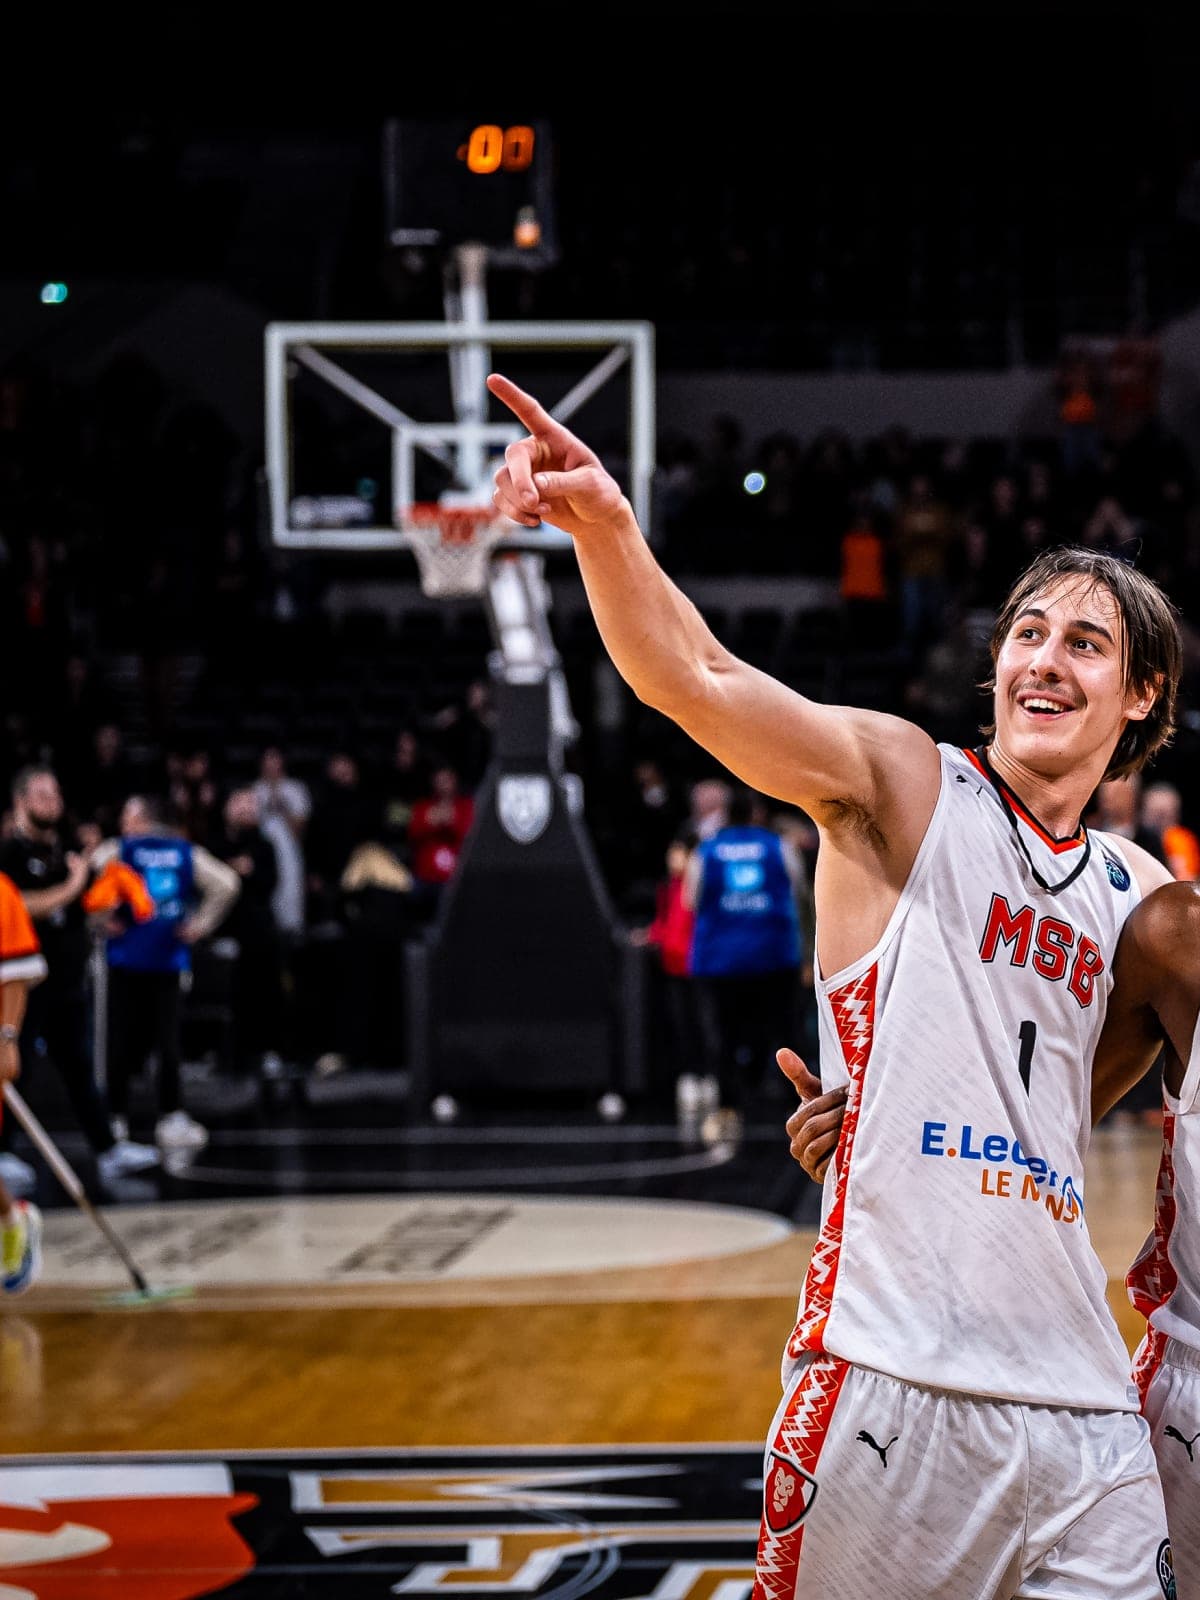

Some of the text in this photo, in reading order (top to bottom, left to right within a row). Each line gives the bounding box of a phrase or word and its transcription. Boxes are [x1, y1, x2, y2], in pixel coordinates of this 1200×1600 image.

[979, 892, 1105, 1009] MSB
[1018, 1020, 1036, 1098] 1
[981, 1168, 1012, 1198] LE
